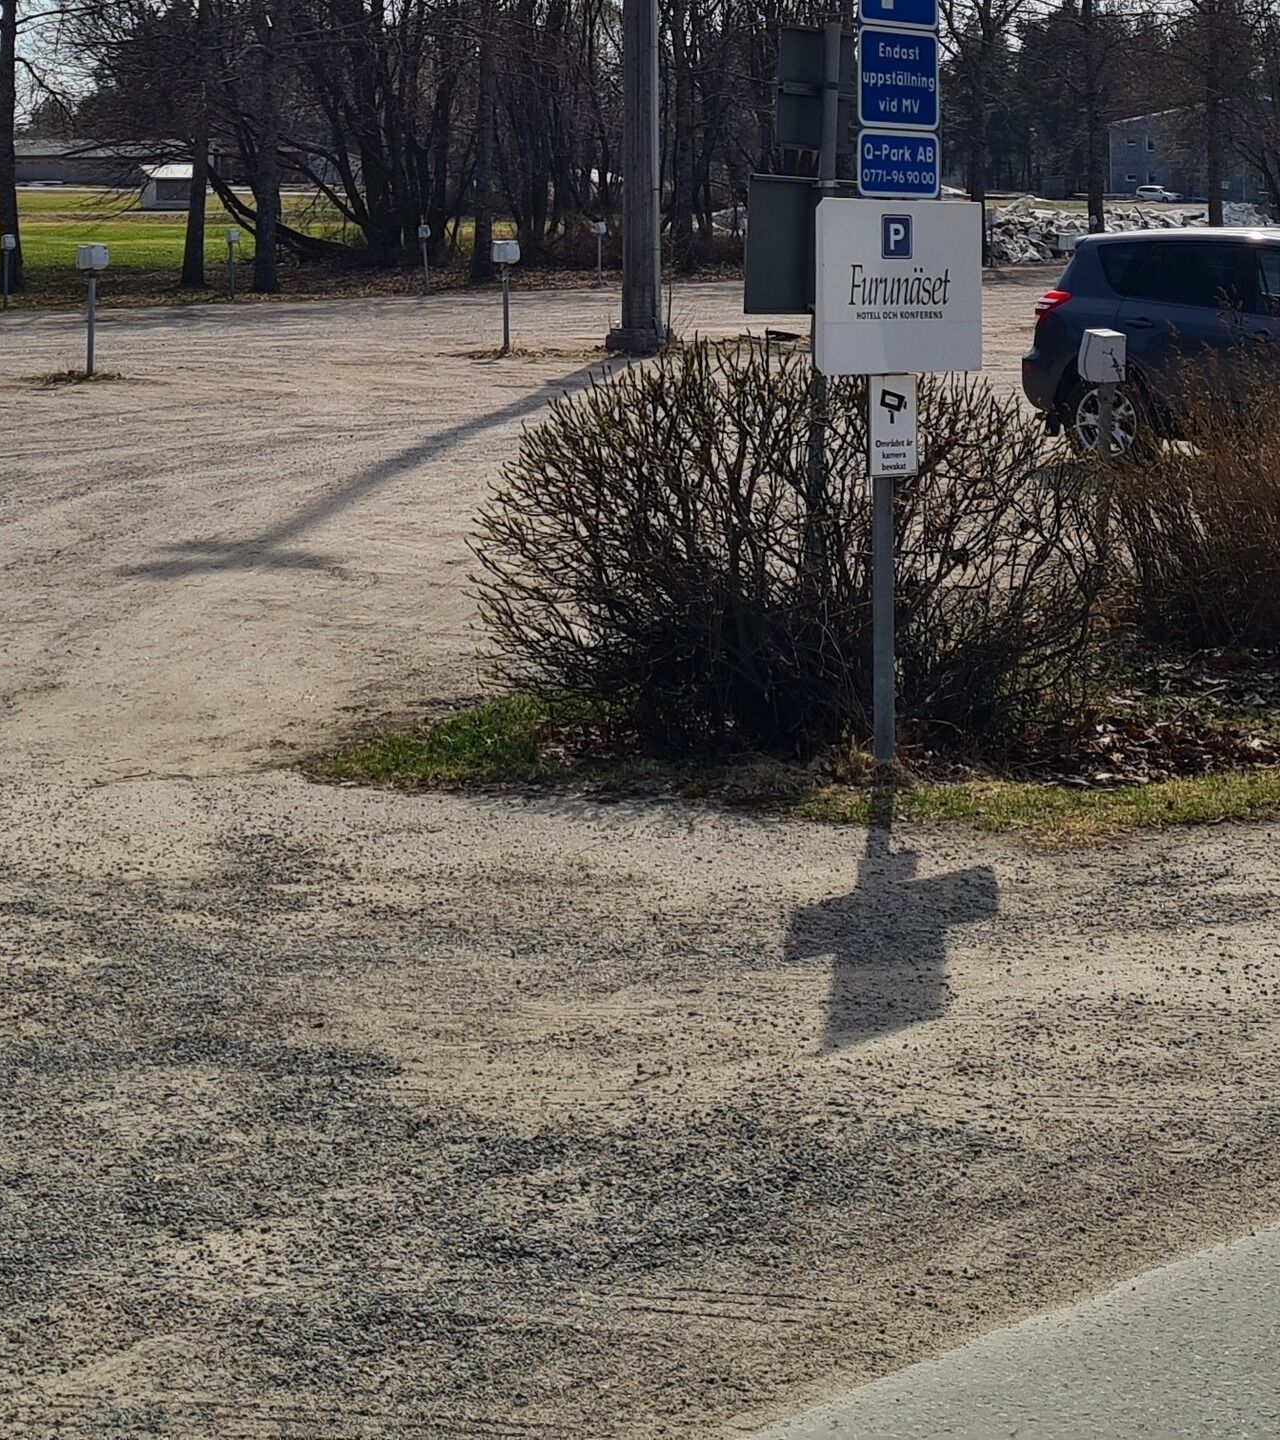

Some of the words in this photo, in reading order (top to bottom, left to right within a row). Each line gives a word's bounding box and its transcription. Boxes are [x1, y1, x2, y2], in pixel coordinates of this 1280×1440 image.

[878, 42, 920, 61] Endast
[862, 71, 936, 92] uppställning
[878, 97, 898, 112] vid
[902, 98, 921, 114] MV
[864, 143, 912, 162] Q-Park
[916, 146, 934, 163] AB
[889, 223, 905, 250] P
[848, 264, 951, 306] Furunäset
[856, 311, 881, 320] HOTELL
[882, 311, 898, 320] OCH
[900, 310, 943, 320] KONFERENS
